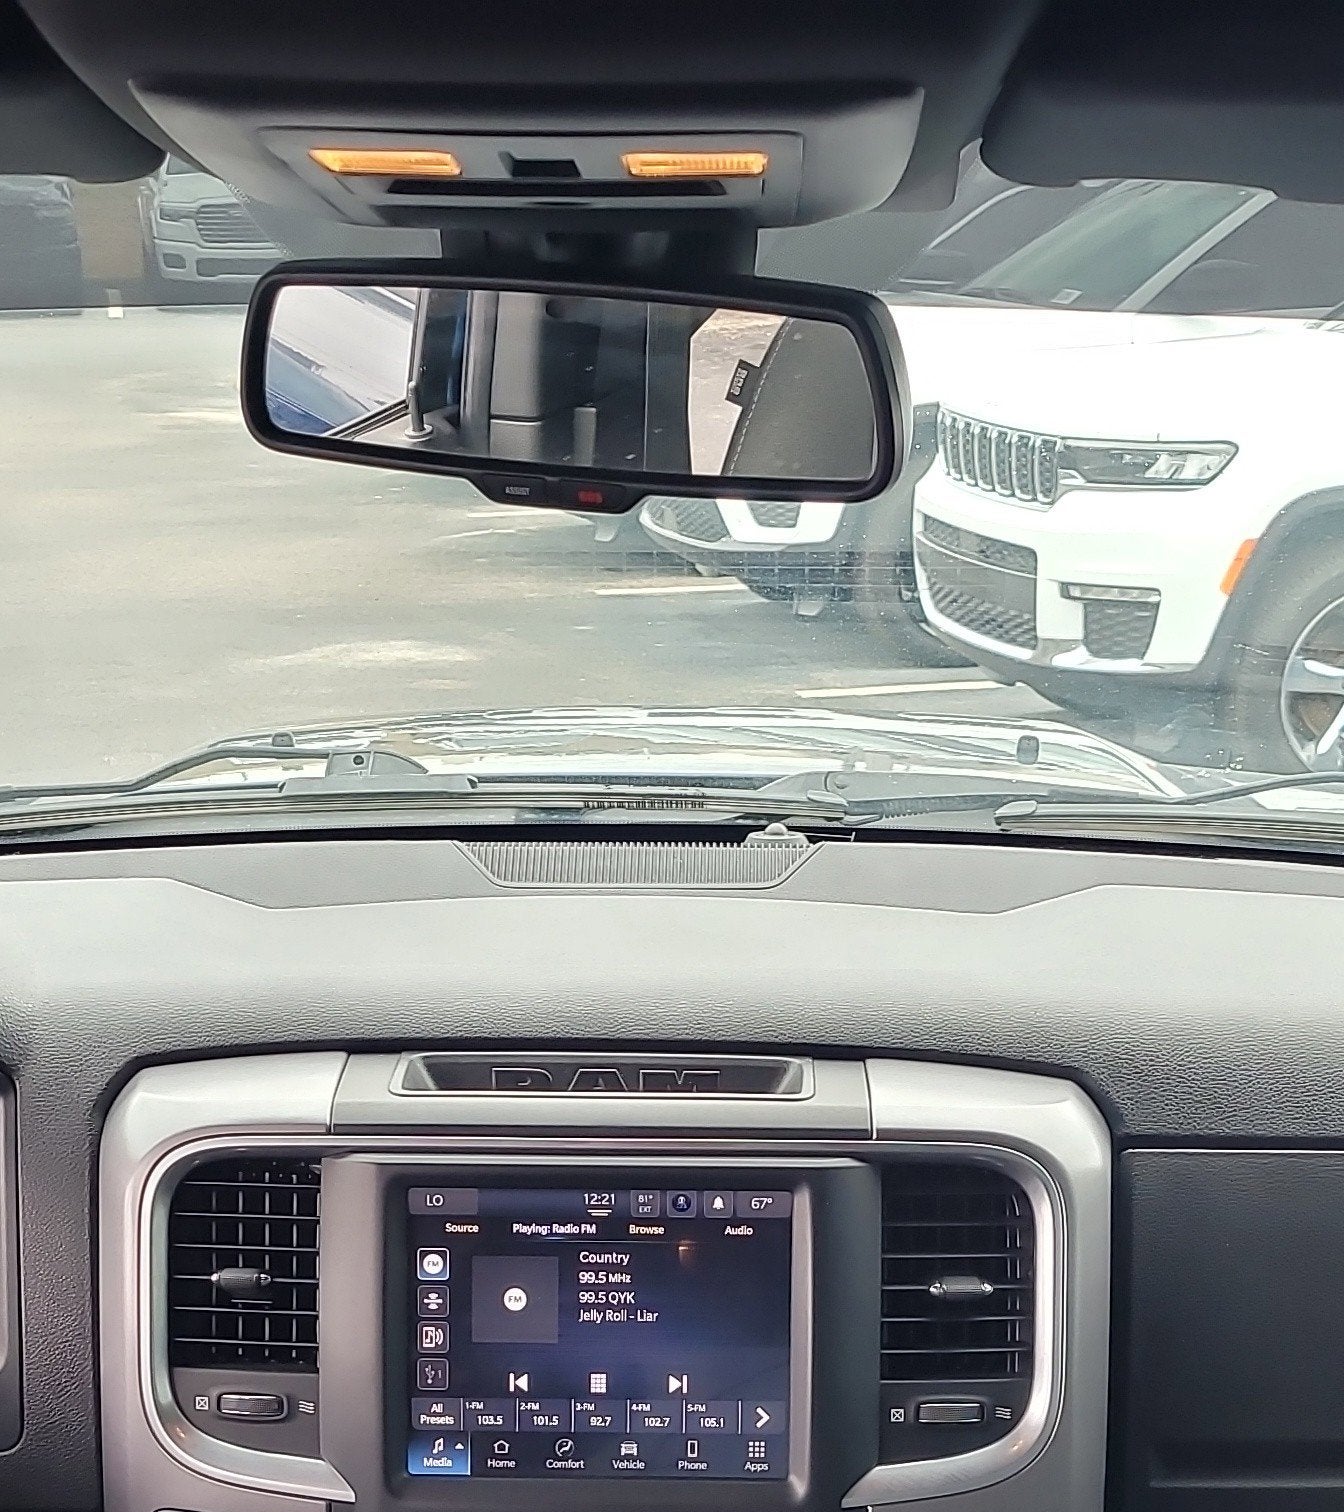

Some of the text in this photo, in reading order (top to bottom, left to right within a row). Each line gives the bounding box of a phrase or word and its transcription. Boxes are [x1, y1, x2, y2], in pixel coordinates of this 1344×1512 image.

[426, 1194, 444, 1206] LO
[583, 1193, 615, 1205] 12:21
[445, 1223, 479, 1232] Source
[513, 1223, 597, 1235] Playing: Radio FM
[629, 1224, 665, 1235] Browse
[724, 1225, 754, 1235] Audio
[579, 1251, 630, 1266] Country
[578, 1271, 631, 1284] 99.5 MHz
[578, 1291, 636, 1305] 99.5 QYK
[578, 1309, 603, 1324] Jelly
[606, 1309, 627, 1322] Roll
[637, 1309, 659, 1322] Liar
[430, 1403, 444, 1413] All
[520, 1402, 540, 1411] 2-FM
[420, 1415, 455, 1425] Presets
[477, 1415, 504, 1425] 103.5
[532, 1416, 559, 1426] 101.5
[589, 1416, 612, 1427] 92.7
[644, 1417, 671, 1427] 102.7
[699, 1417, 725, 1428] 105.1
[423, 1457, 453, 1467] Media
[487, 1458, 516, 1468] Home
[546, 1459, 585, 1469] Comfort
[612, 1459, 646, 1470] Vehicle
[678, 1460, 707, 1470] Phone
[744, 1461, 769, 1472] Apps
